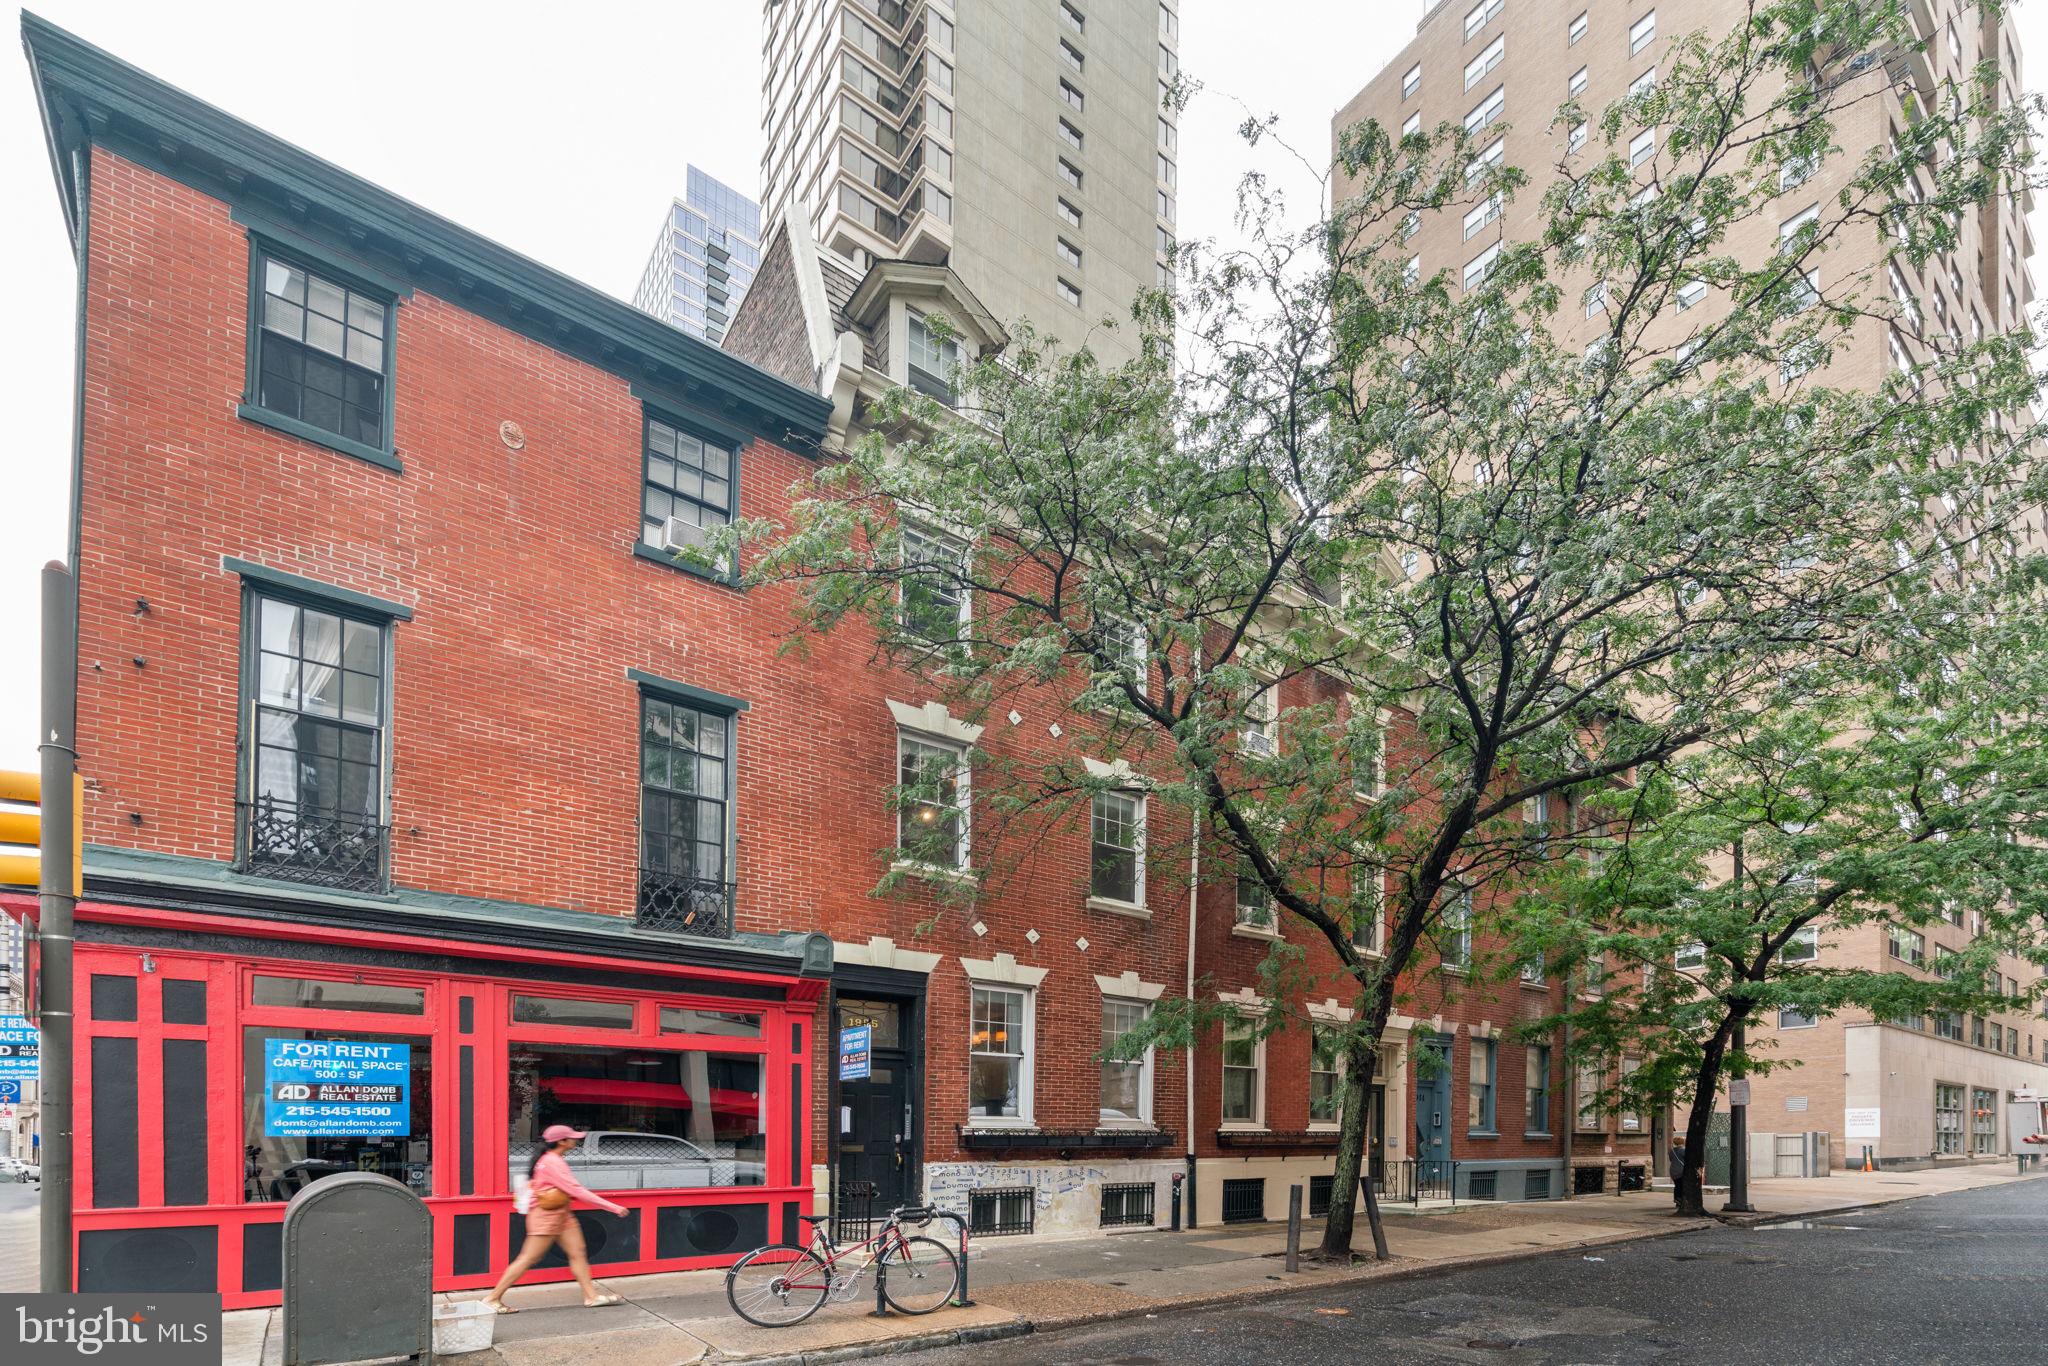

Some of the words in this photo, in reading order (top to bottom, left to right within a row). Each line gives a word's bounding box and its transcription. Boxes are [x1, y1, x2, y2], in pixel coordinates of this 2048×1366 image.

[0, 1031, 24, 1042] ACE
[26, 1031, 40, 1042] FO
[0, 1045, 12, 1056] D
[282, 1043, 328, 1056] FOR
[335, 1044, 392, 1058] RENT
[844, 1042, 853, 1051] FOR
[853, 1040, 865, 1049] RENT
[273, 1058, 359, 1069] CAFE/RETAIL
[362, 1061, 403, 1071] SPACE
[348, 1071, 365, 1079] SF
[278, 1085, 311, 1100] AD
[362, 1086, 396, 1094] DOMB
[354, 1094, 396, 1102] ESTATE
[286, 1106, 391, 1116] 215-545-1500
[274, 1119, 402, 1127] domb@allandomb.com
[283, 1127, 394, 1135] www.allandomb.com
